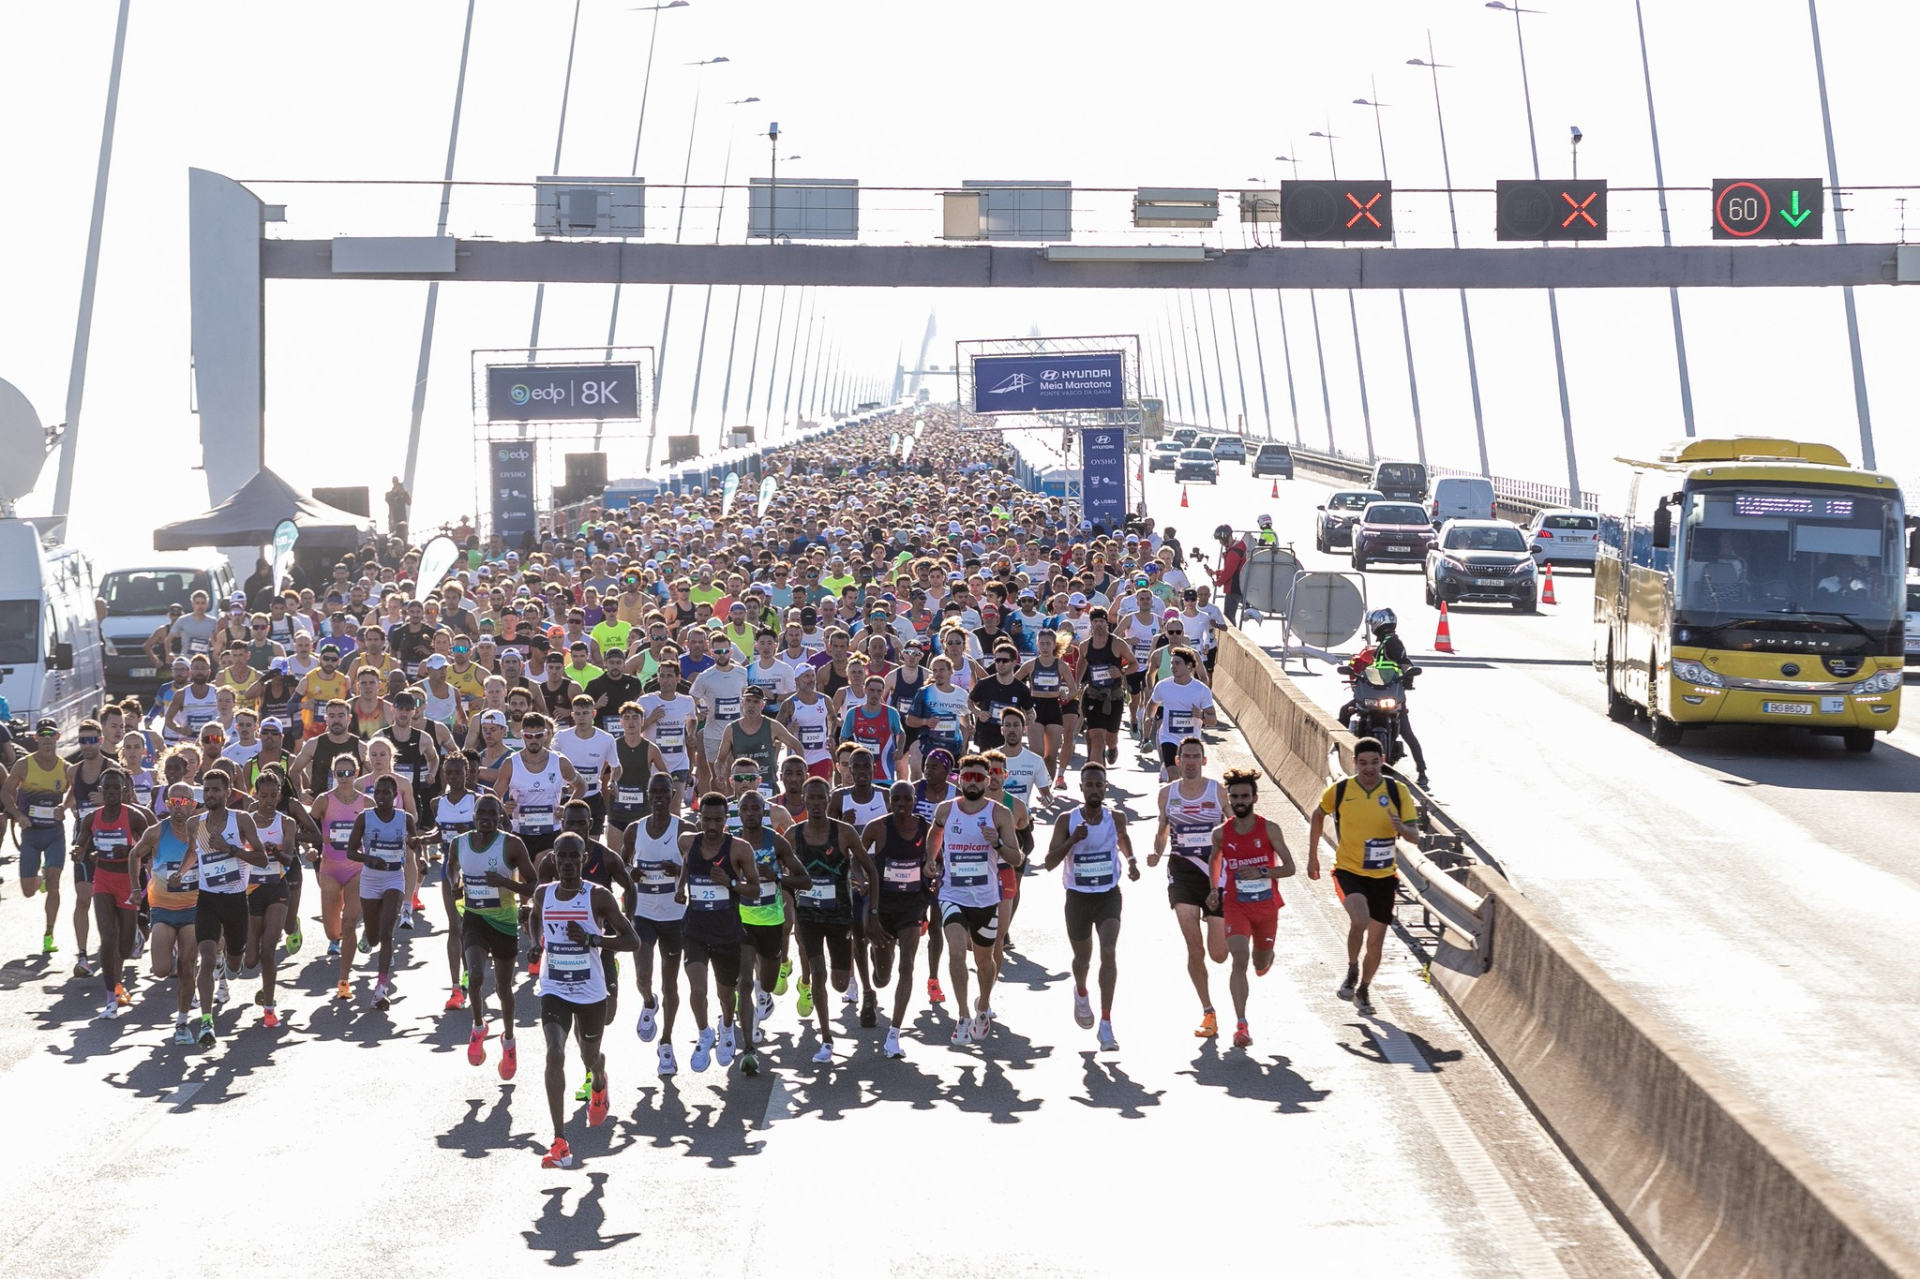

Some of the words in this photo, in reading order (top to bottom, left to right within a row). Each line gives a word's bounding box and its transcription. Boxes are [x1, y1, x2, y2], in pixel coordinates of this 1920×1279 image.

[1729, 197, 1757, 220] 60
[1062, 369, 1111, 379] HYUNDAI
[1040, 382, 1063, 390] Meia
[1065, 381, 1112, 389] Maratona
[531, 383, 565, 404] edp
[581, 381, 619, 404] 8K
[509, 449, 529, 460] edp
[1754, 638, 1829, 646] YUTONG
[1832, 701, 1844, 709] TP
[1238, 856, 1268, 866] navarra
[214, 865, 226, 874] 26
[702, 891, 715, 899] 25
[811, 889, 822, 897] 24
